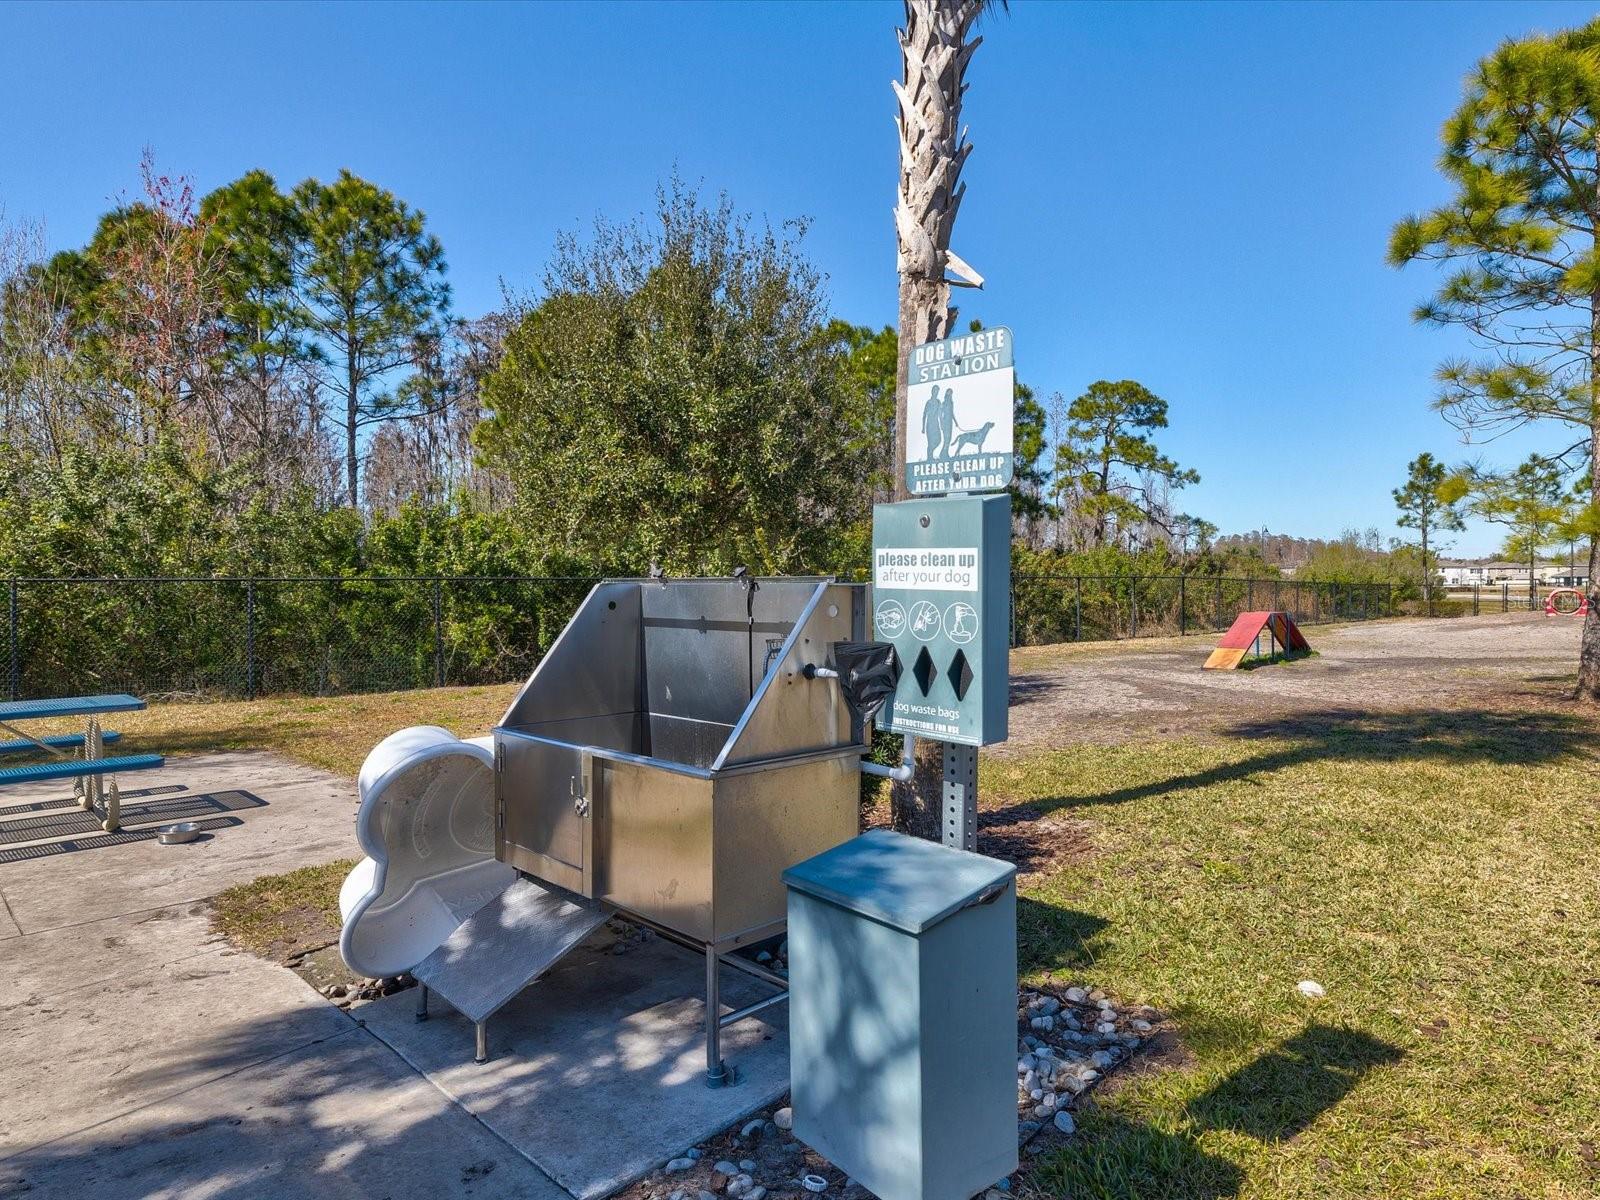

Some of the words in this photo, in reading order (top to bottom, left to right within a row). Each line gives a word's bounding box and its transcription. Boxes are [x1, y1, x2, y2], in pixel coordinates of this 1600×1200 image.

[915, 344, 944, 365] DOG
[950, 329, 1004, 357] WASTE
[920, 353, 999, 383] STATION
[913, 462, 949, 477] PLEASE
[953, 458, 986, 473] CLEAN
[990, 456, 1004, 469] UP
[915, 479, 945, 492] AFTER
[980, 474, 1002, 487] DOG
[878, 552, 917, 567] please
[920, 552, 955, 567] clean
[958, 554, 975, 568] up
[882, 568, 909, 582] after
[913, 572, 941, 585] your
[944, 569, 970, 587] dog
[893, 701, 909, 714] dog
[910, 704, 936, 716] waste
[938, 706, 960, 720] bags
